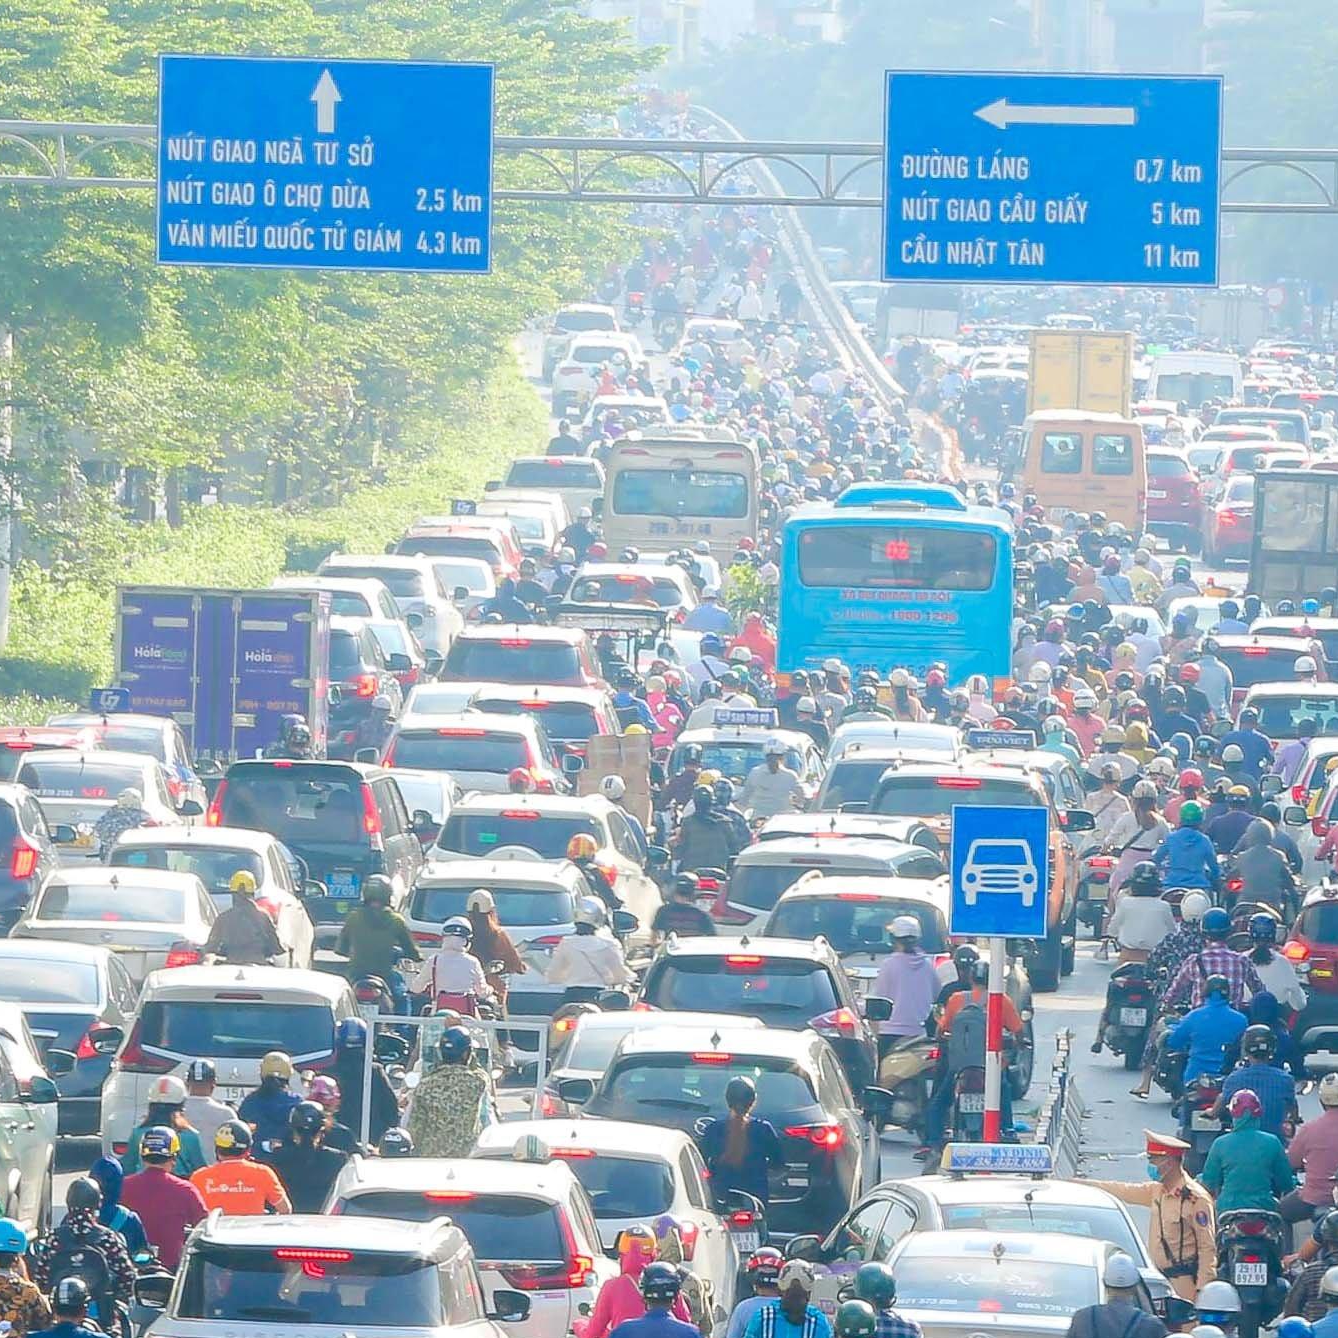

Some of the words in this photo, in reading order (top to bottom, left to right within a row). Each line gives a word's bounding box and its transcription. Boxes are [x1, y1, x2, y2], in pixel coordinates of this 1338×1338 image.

[167, 132, 205, 162] NÚT
[212, 138, 256, 163] GIAO
[265, 137, 304, 165] NGÃ
[314, 140, 340, 165] TƯ
[348, 136, 374, 167] SỞ
[902, 148, 968, 179] ĐƯỜNG
[978, 148, 1029, 181] LÁNG
[1172, 159, 1202, 182] km
[167, 175, 204, 205] NÚT
[212, 182, 254, 206] GIAO
[264, 180, 276, 207] Ô
[284, 182, 324, 212] CHỢ
[332, 177, 370, 209] DỪA
[453, 188, 481, 212] km
[902, 191, 940, 221] NÚT
[947, 199, 991, 222] GIAO
[999, 193, 1036, 223] CẦU
[1045, 192, 1088, 225] GIẤY
[1152, 202, 1163, 224] 5
[1171, 202, 1200, 225] km
[168, 222, 204, 247] VĂN
[211, 217, 257, 249] MIẾU
[264, 217, 314, 251] QUỐC
[321, 220, 346, 252] TỬ
[354, 222, 401, 253] GIÁM
[452, 232, 480, 255] km
[901, 233, 938, 264] CẦU
[947, 237, 997, 268] NHẬT
[1007, 237, 1045, 266] TÂN
[1144, 244, 1162, 267] 11
[1170, 244, 1200, 267] km
